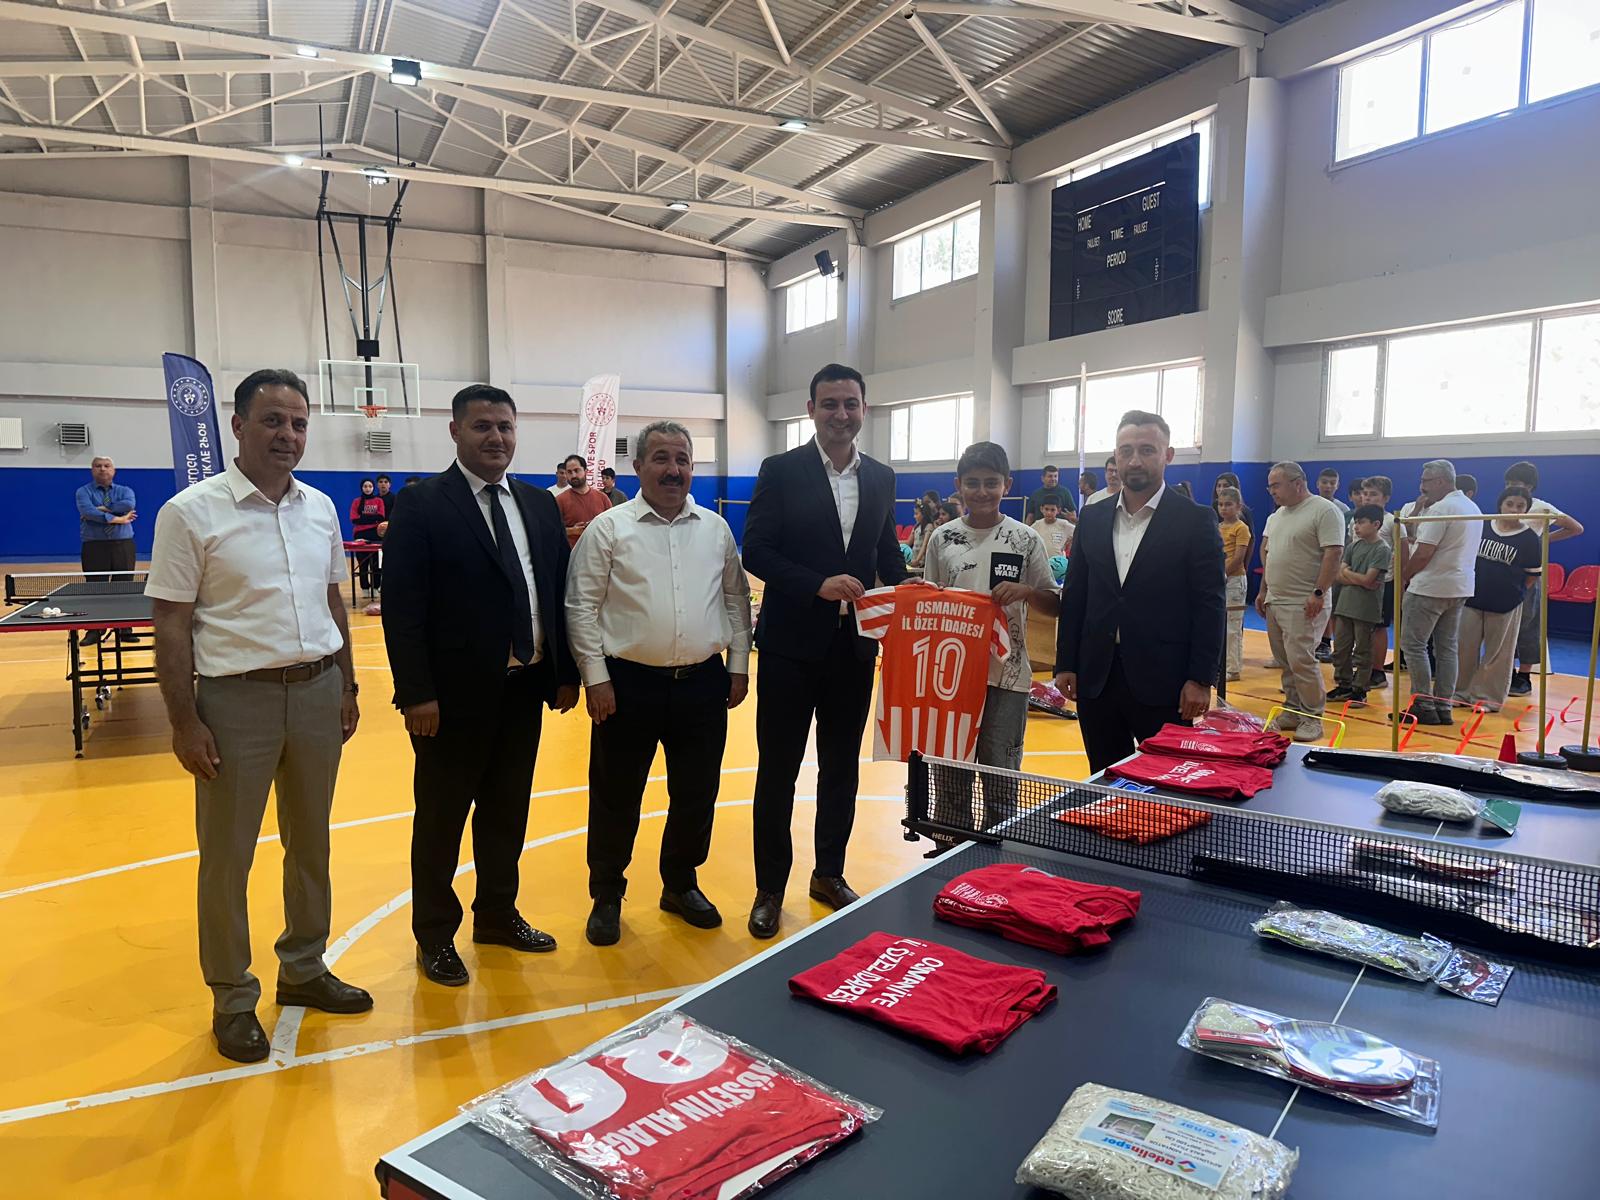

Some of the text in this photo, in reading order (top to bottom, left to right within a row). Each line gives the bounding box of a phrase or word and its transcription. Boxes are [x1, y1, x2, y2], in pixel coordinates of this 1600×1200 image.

[1142, 192, 1160, 211] GUEST
[1078, 214, 1091, 232] HOME
[1111, 227, 1124, 240] TIME
[1107, 250, 1126, 267] PERIOD
[1107, 308, 1123, 324] SCORE
[588, 431, 596, 456] SPOR
[587, 456, 595, 467] VE
[994, 569, 1019, 578] WARS
[995, 563, 1019, 571] STAR
[916, 601, 977, 619] OSMANİYE
[901, 615, 985, 638] İL ÖZEL İDARESİ
[912, 634, 966, 701] 10
[931, 832, 955, 842] HELIX
[866, 947, 916, 972] ÖZEL
[870, 957, 944, 1008] OSMANİYE
[1101, 1136, 1175, 1166] adelinspor
